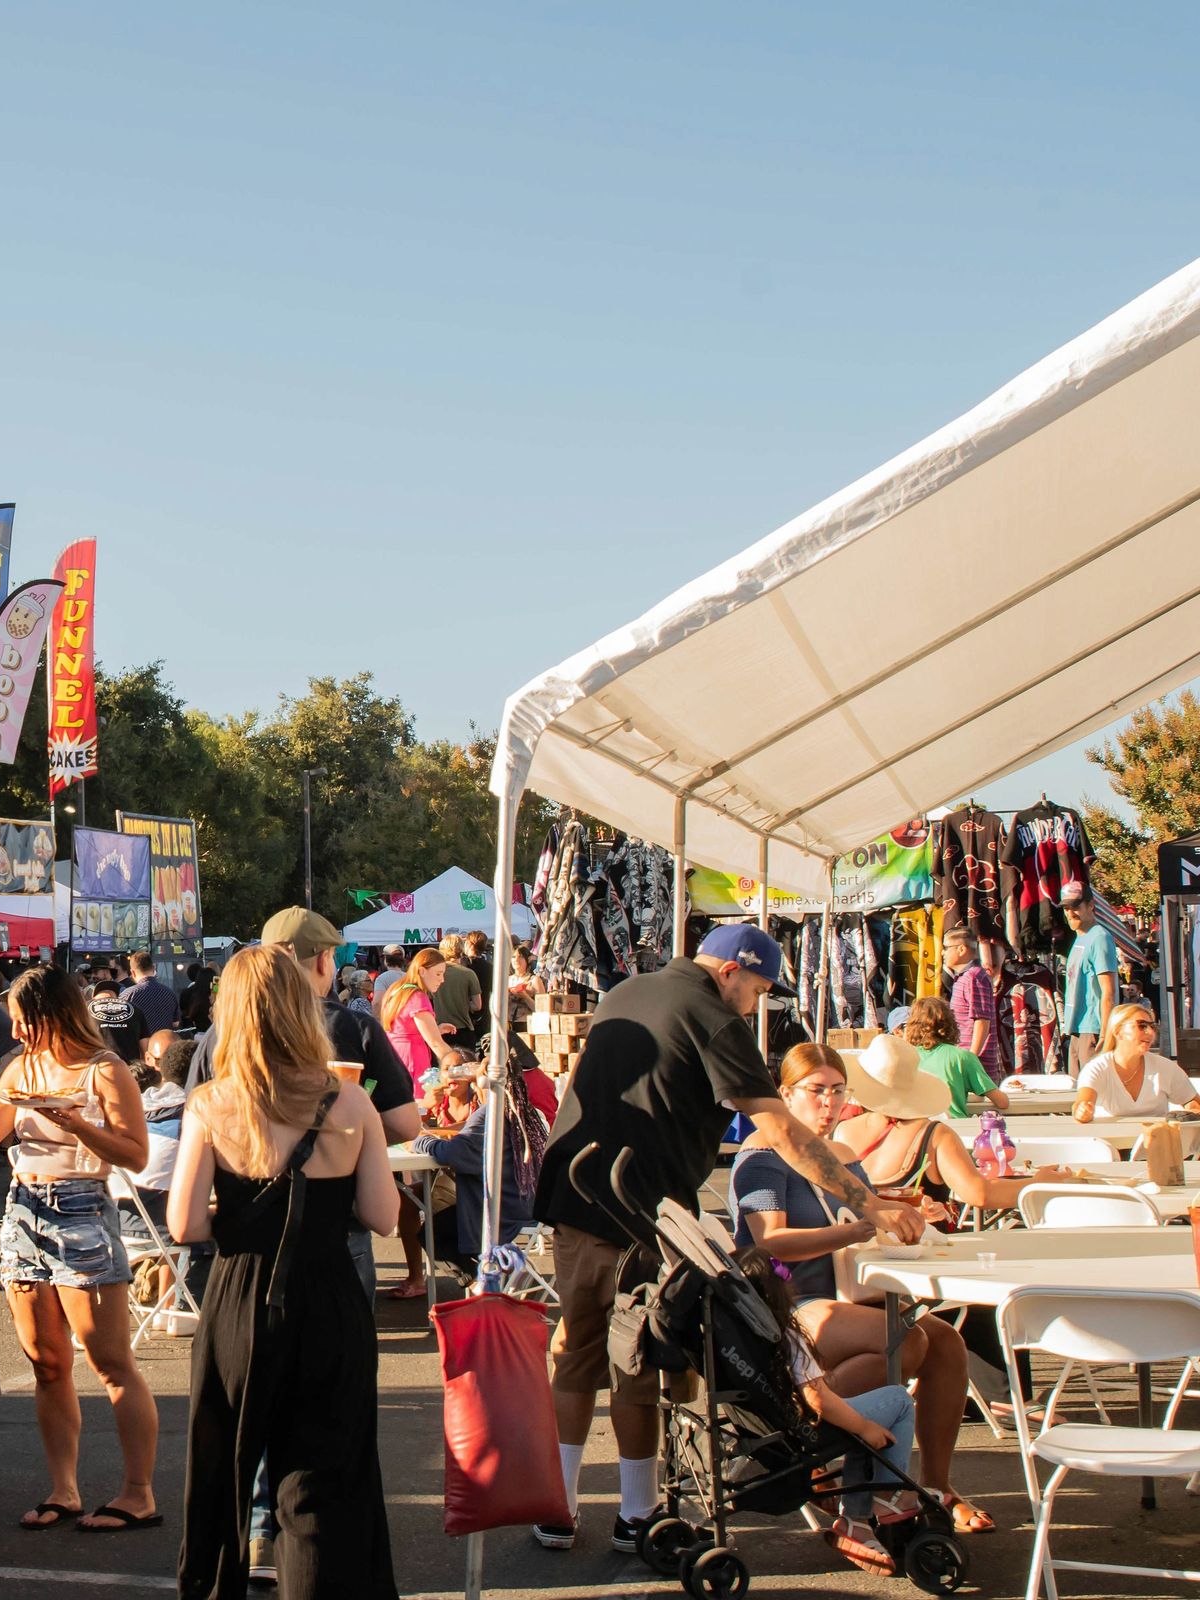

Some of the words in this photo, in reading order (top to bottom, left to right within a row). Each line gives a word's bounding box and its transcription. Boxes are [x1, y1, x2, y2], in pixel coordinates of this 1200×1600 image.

[54, 569, 89, 728] FUNNEL
[50, 750, 93, 768] CAKES
[720, 1345, 755, 1378] Jeep
